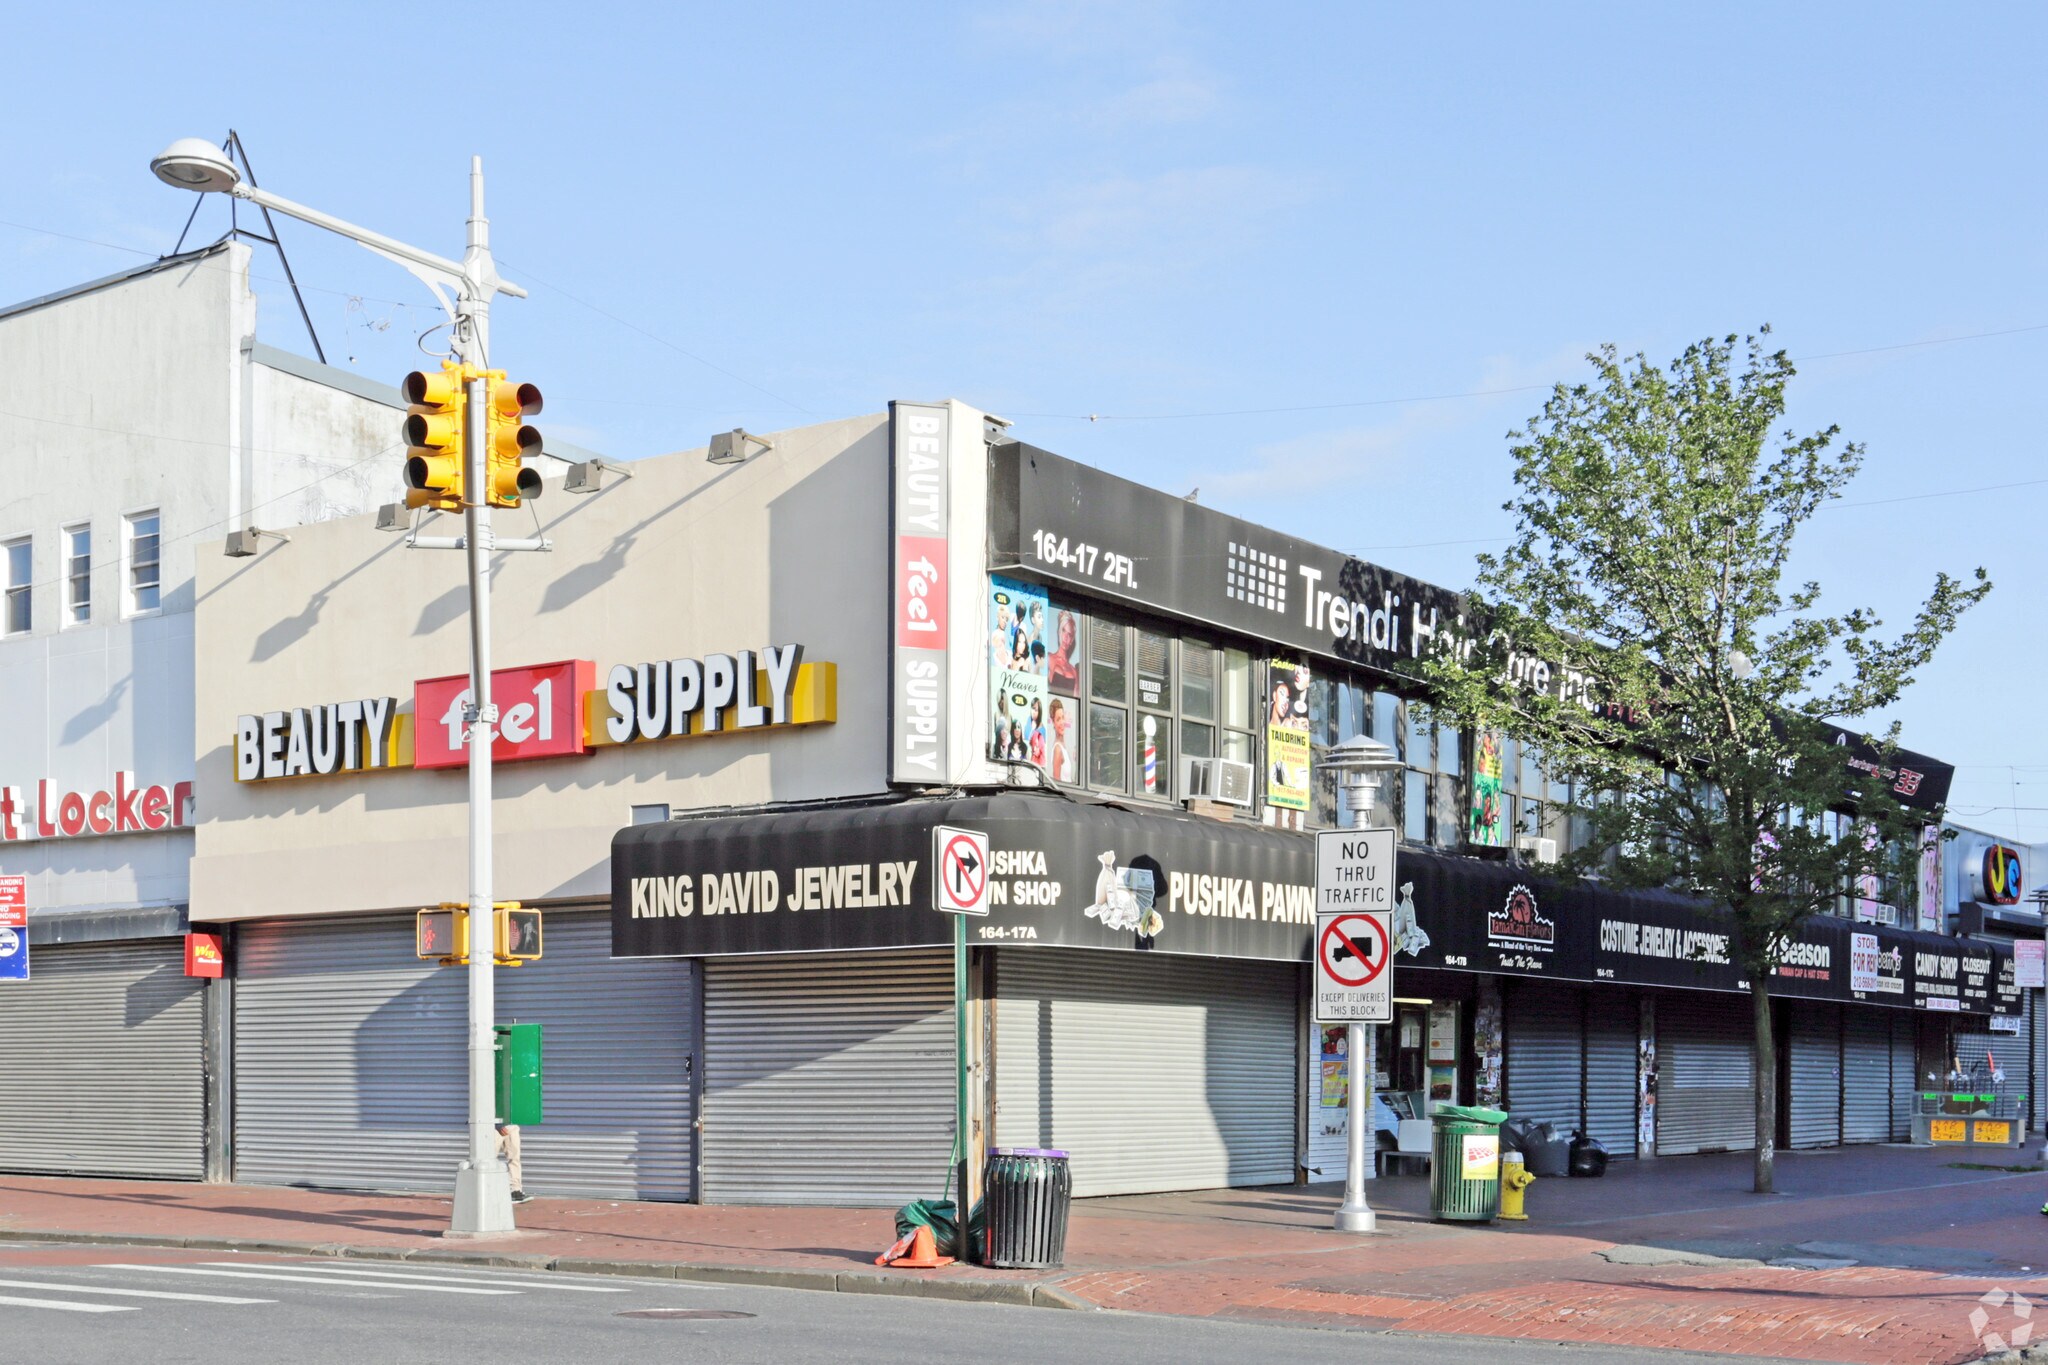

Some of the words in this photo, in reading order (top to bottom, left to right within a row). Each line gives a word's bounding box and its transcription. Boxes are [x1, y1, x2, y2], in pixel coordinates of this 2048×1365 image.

[908, 415, 939, 531] BEAUTY
[1033, 529, 1098, 576] 164-17
[907, 555, 937, 632] feel
[1299, 565, 1398, 653] Trendi
[606, 643, 804, 743] SUPPLY
[1000, 671, 1038, 693] Weaves
[440, 678, 552, 750] fel
[906, 659, 937, 771] SUPPLY
[238, 697, 397, 781] BEAUTY
[1271, 730, 1306, 746] TAILORING
[37, 771, 195, 837] Locker
[1342, 842, 1370, 860] NO
[631, 874, 694, 919] KING
[702, 869, 780, 916] DAVID
[787, 860, 918, 912] JEWELRY
[1336, 866, 1376, 881] THRU
[1013, 881, 1062, 906] SHOP
[1169, 871, 1256, 921] PUSHKA
[1261, 876, 1316, 925] PAWN
[1325, 887, 1385, 904] TRAFFIC
[978, 926, 1038, 939] 164-17A
[1600, 918, 1640, 955] COSTUME
[1640, 924, 1676, 959] JEWELRY
[1676, 928, 1682, 959] &
[195, 944, 216, 959] Wig
[1779, 934, 1831, 968] Season
[1915, 952, 1940, 978] CANDY
[1940, 955, 1959, 980] SHOP
[1962, 956, 1992, 975] CLOSEOUT
[1321, 992, 1345, 1003] EXCEPT
[1347, 992, 1386, 1003] DELIVERIES
[1330, 1005, 1348, 1016] THIS
[1350, 1005, 1377, 1016] BLOCK
